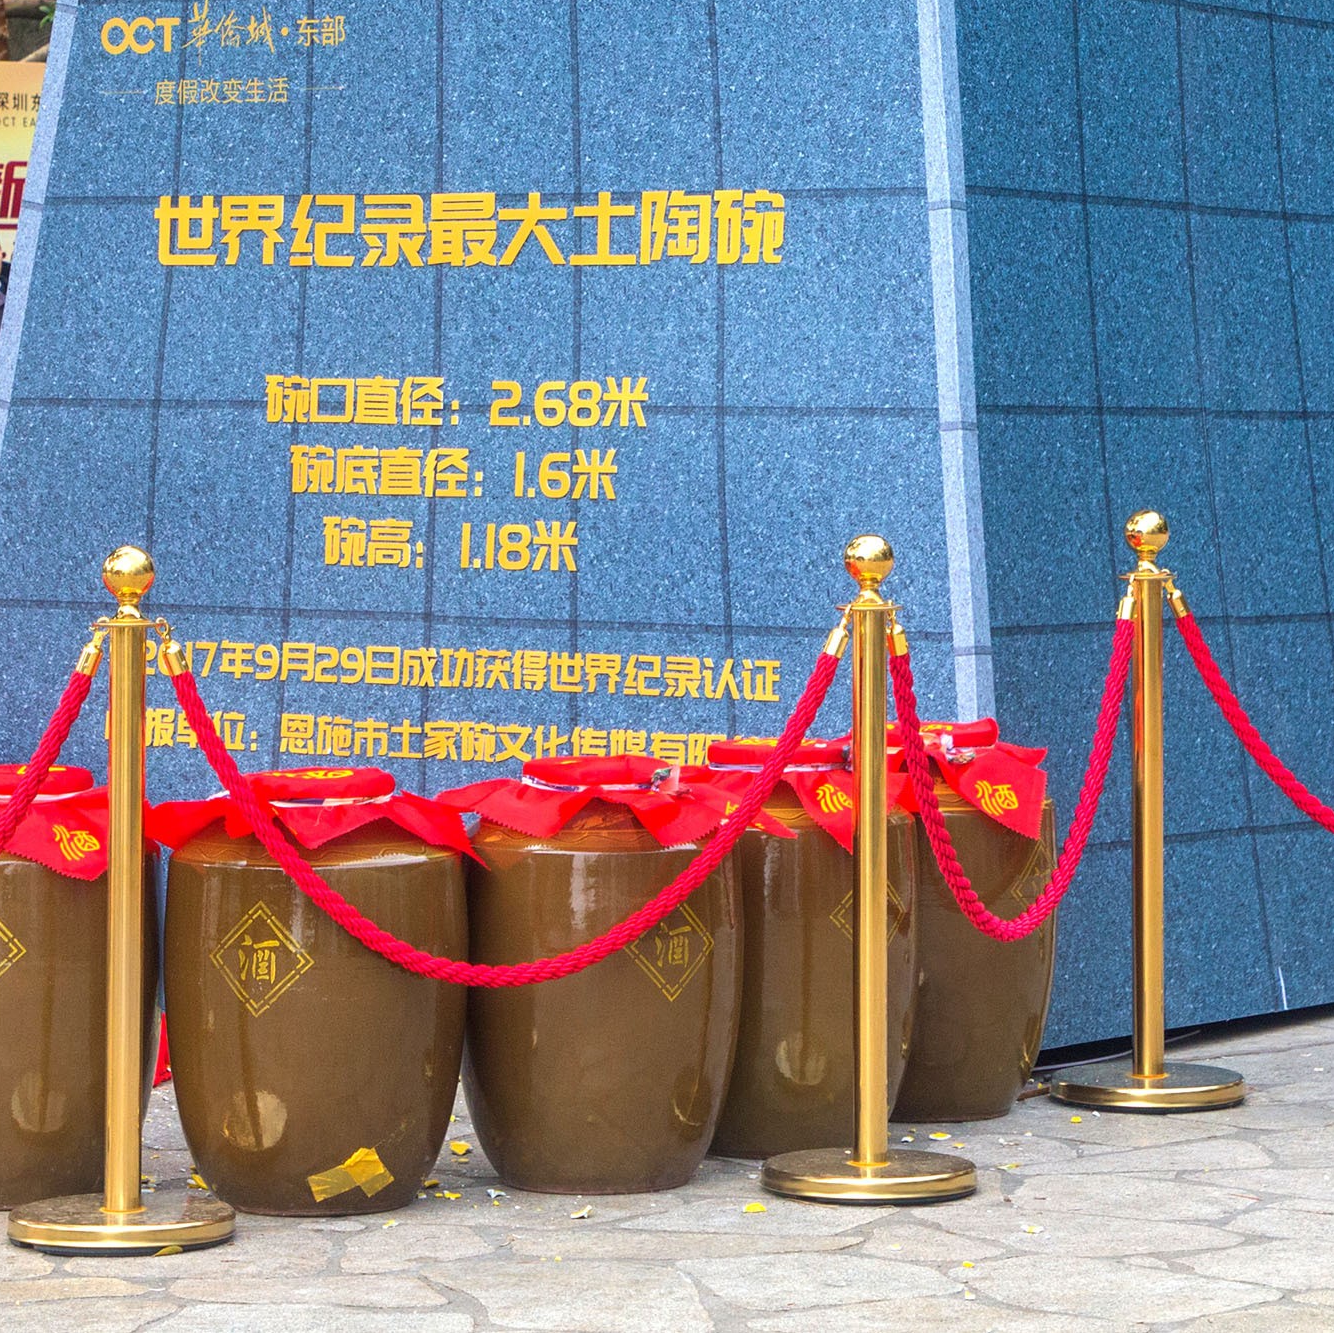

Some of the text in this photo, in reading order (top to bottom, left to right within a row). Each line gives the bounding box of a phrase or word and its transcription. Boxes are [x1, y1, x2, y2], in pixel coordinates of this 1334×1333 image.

[100, 16, 181, 55] OCT
[154, 77, 290, 105] 度假改变生活
[153, 189, 785, 268] 世界纪录最大土陶碗
[238, 933, 280, 985] 酒
[654, 921, 694, 971] 酒
